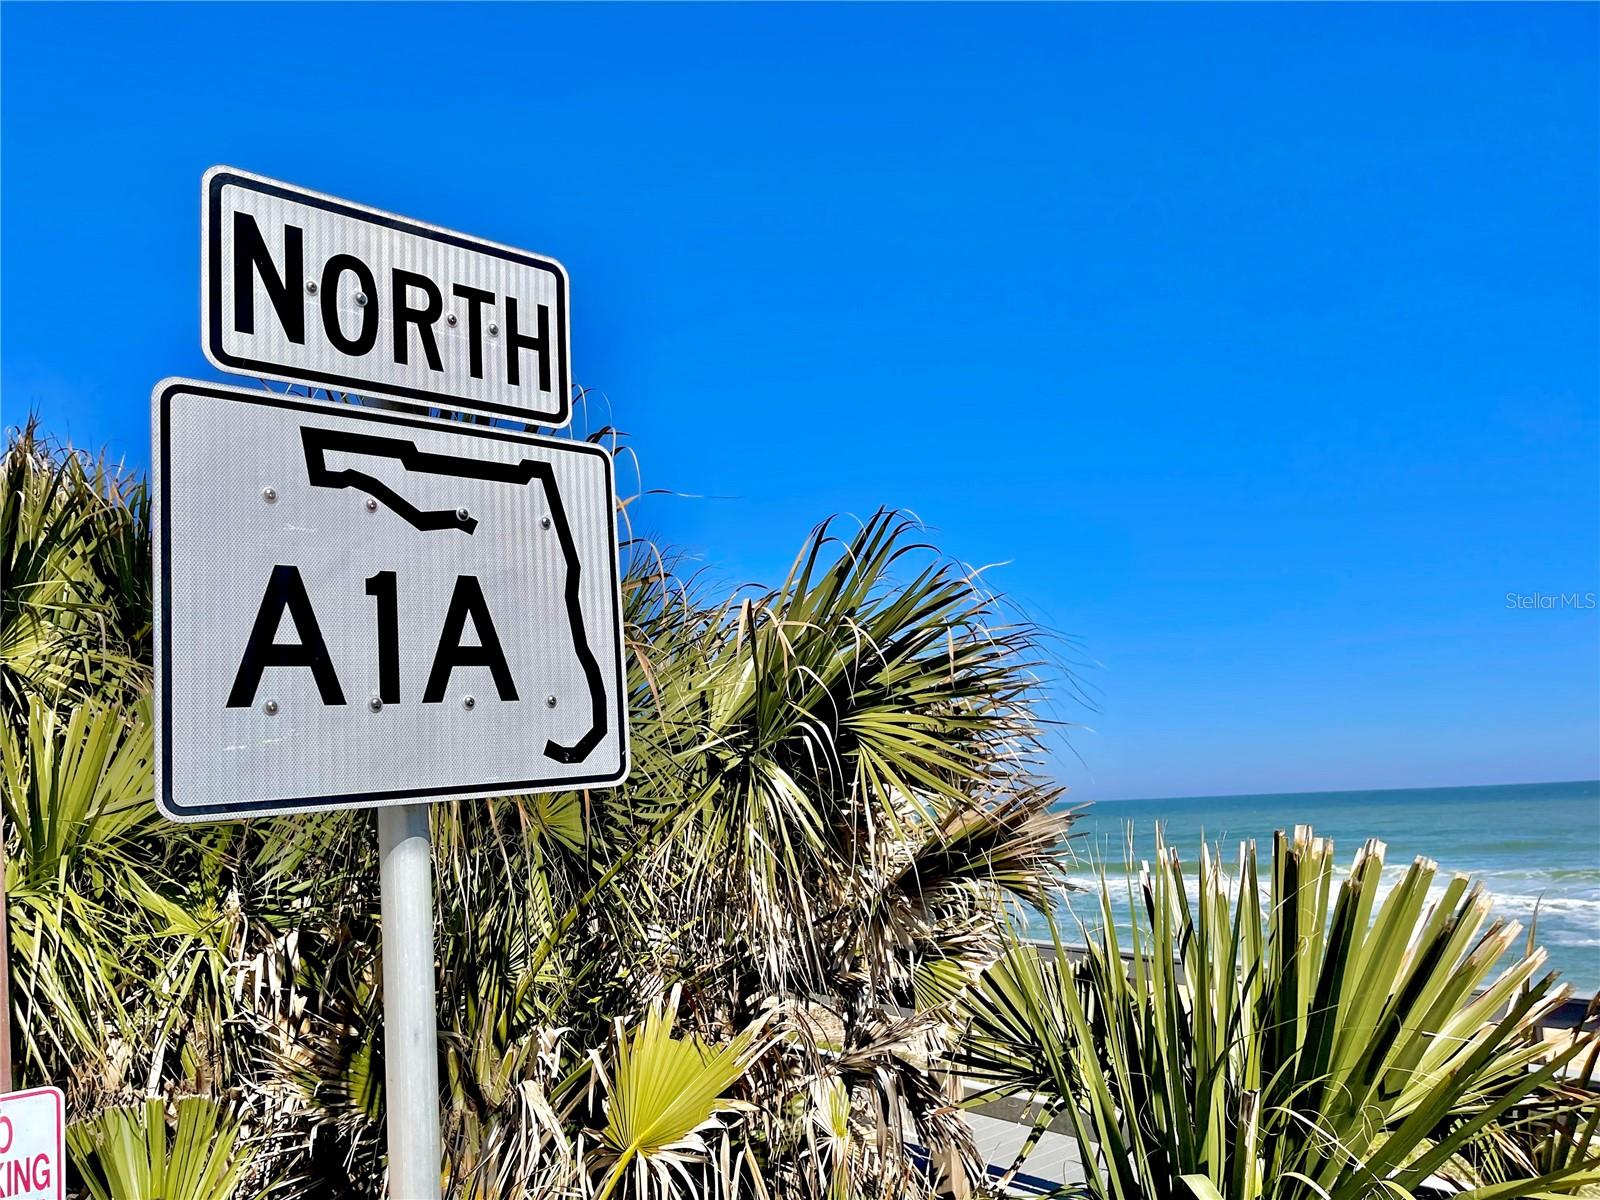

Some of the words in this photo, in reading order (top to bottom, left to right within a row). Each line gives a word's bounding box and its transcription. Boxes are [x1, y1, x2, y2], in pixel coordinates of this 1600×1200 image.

[233, 211, 551, 392] NORTH
[226, 565, 519, 708] A1A
[0, 1116, 13, 1154] O
